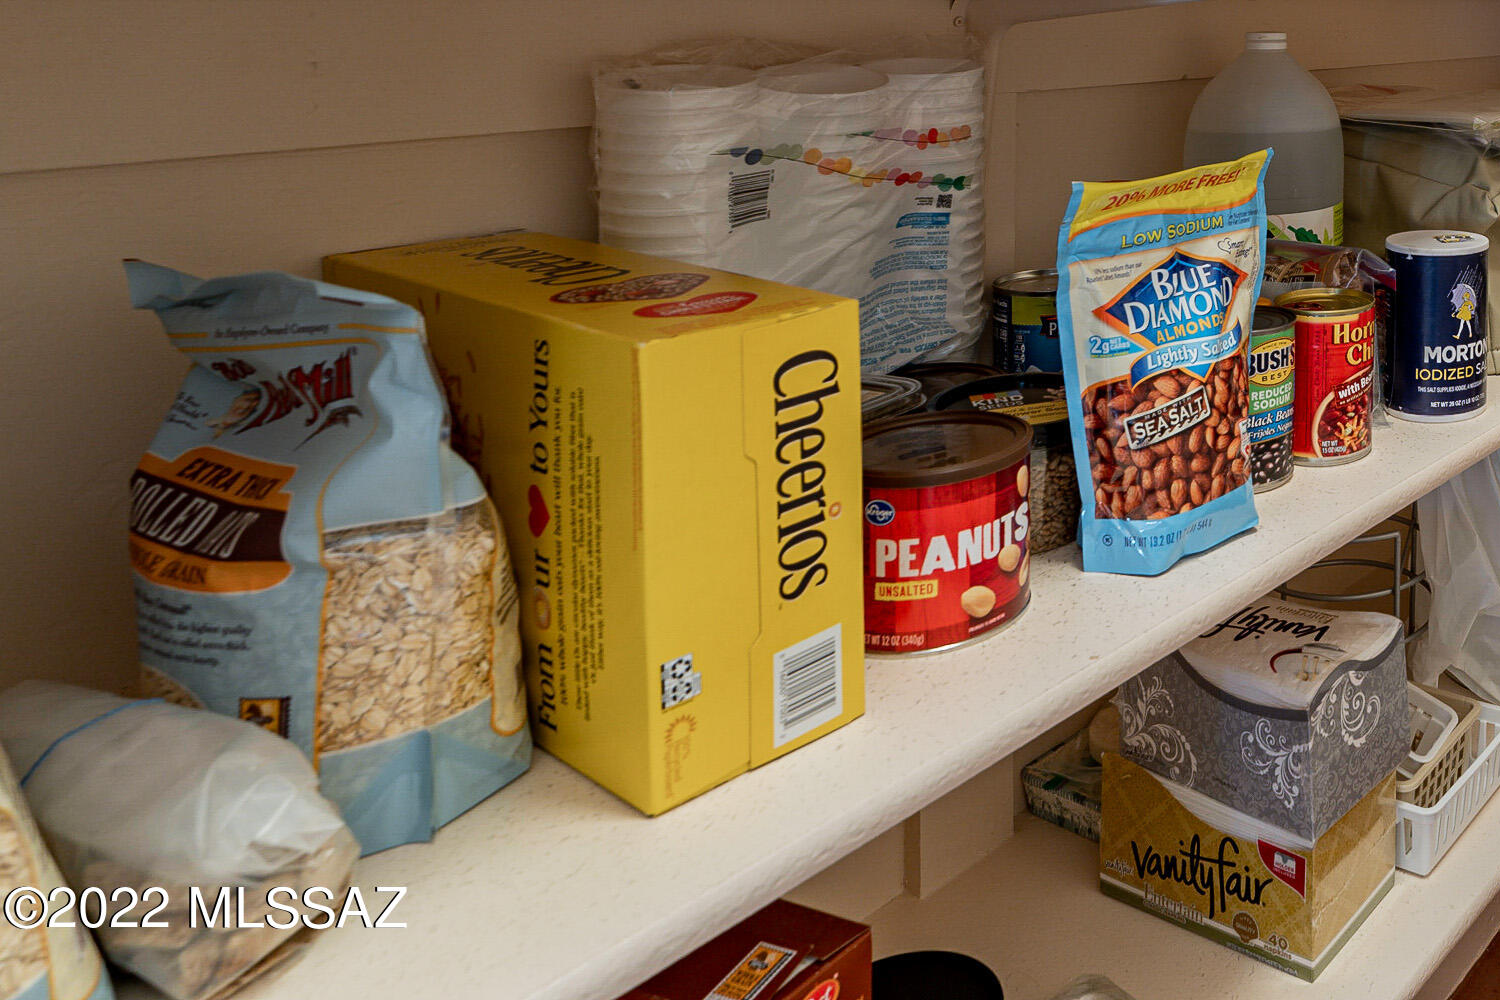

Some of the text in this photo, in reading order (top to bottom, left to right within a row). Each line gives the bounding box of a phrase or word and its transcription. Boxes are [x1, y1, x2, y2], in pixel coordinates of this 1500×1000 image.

[1101, 176, 1196, 212] 20% MORE
[1121, 215, 1225, 249] LOW SODIUM
[1150, 263, 1217, 301] BLUE
[1123, 276, 1233, 335] DIAMOND
[1156, 311, 1225, 345] ALMONDS
[1146, 344, 1199, 370] Lightly
[1249, 341, 1296, 378] BUSH'S
[1423, 337, 1489, 365] MORTON
[1261, 369, 1288, 383] BEST
[1415, 365, 1474, 381] IODIZED
[970, 394, 1024, 408] KIND
[1250, 381, 1293, 401] REDUCED
[1252, 391, 1292, 411] SODIUM
[1337, 383, 1359, 400] with
[1133, 395, 1204, 440] SEA SALT
[1248, 425, 1276, 442] Frijoles
[176, 457, 238, 497] EXTRA
[773, 349, 841, 602] Cheerios
[130, 477, 219, 547] OLLED
[528, 338, 558, 733] From to Yours
[875, 501, 1030, 578] PEANUTS
[879, 581, 934, 598] UNSALTED
[882, 635, 890, 646] 12
[891, 635, 900, 646] OZ
[1274, 860, 1297, 875] HOLDER
[1263, 943, 1294, 961] napkins
[1268, 932, 1290, 951] 40
